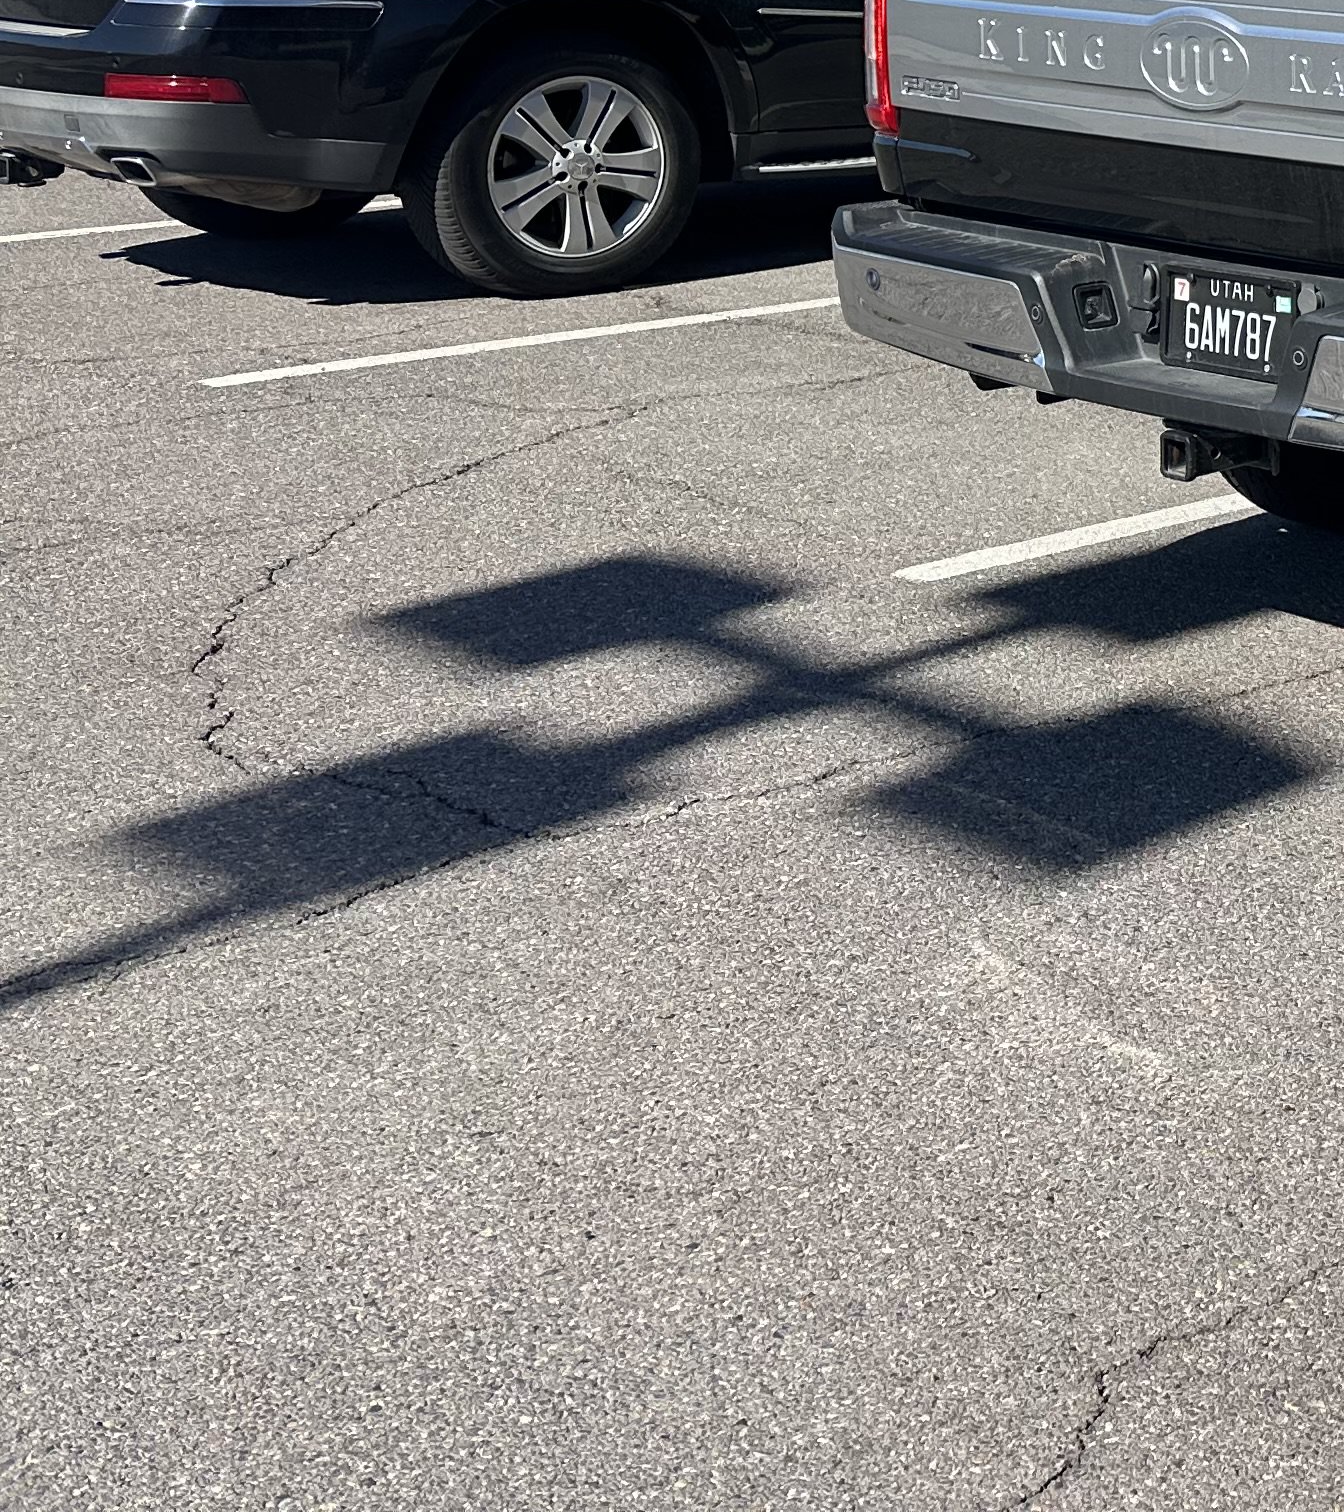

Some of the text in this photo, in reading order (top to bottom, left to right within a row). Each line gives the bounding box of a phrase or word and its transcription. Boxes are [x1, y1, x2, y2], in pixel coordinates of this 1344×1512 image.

[977, 18, 1106, 71] KING
[1210, 278, 1254, 303] UTAH
[1185, 302, 1277, 362] 6AM787
